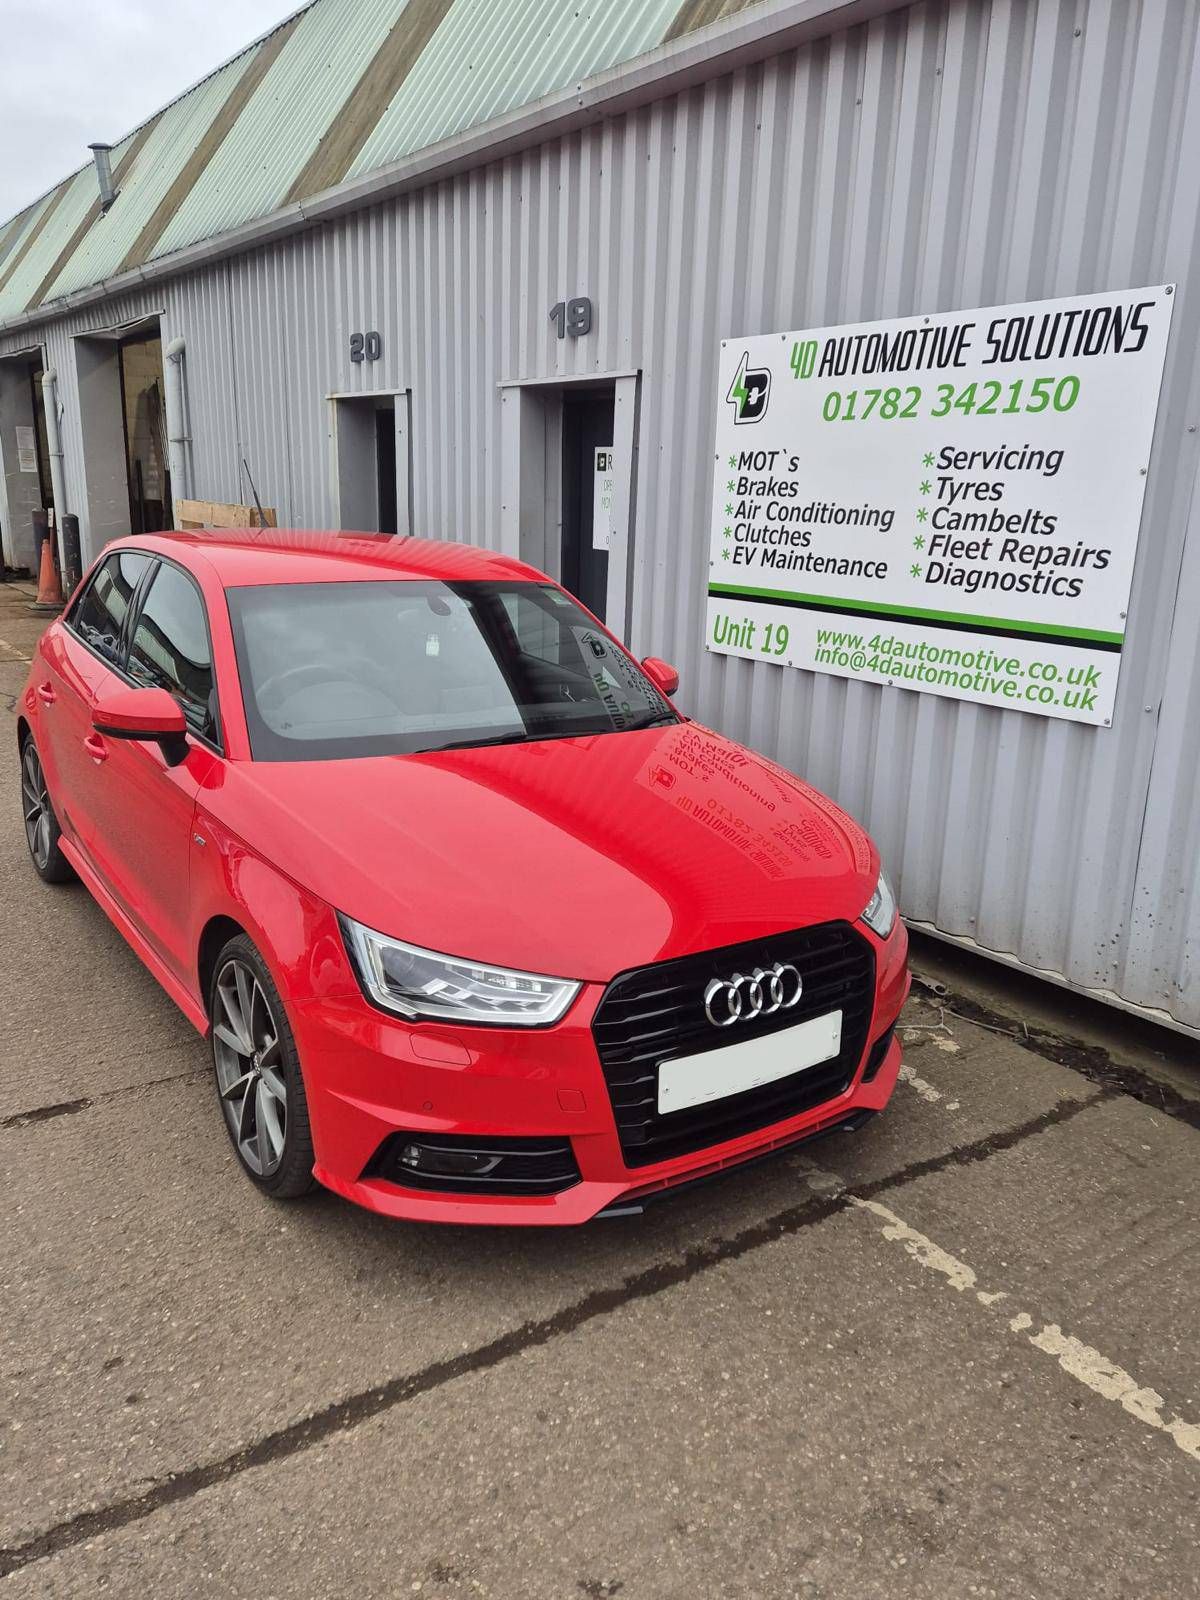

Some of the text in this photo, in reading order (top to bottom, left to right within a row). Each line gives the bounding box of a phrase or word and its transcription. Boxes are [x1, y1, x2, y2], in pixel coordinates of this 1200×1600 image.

[550, 297, 592, 339] 19
[350, 331, 381, 362] 20
[790, 302, 1157, 380] 4D AUTOMOTIVE SOLUTIONS
[823, 376, 1080, 421] 01782 342150
[936, 444, 1065, 476] Servicing
[736, 476, 798, 499] Brakes
[937, 477, 1005, 505] Tyres
[734, 499, 896, 533] Air Conditioning
[932, 507, 1057, 536] Cambelts
[734, 523, 812, 548] Clutches
[927, 535, 1111, 570] Fleet Repairs
[732, 546, 888, 579] EV Maintenance
[925, 562, 1084, 597] Diagnostics
[713, 614, 789, 656] Unit 19
[817, 629, 1102, 689] www.4dautomotive.co.uk
[814, 646, 1098, 711] info@4dautomotive.co.uk
